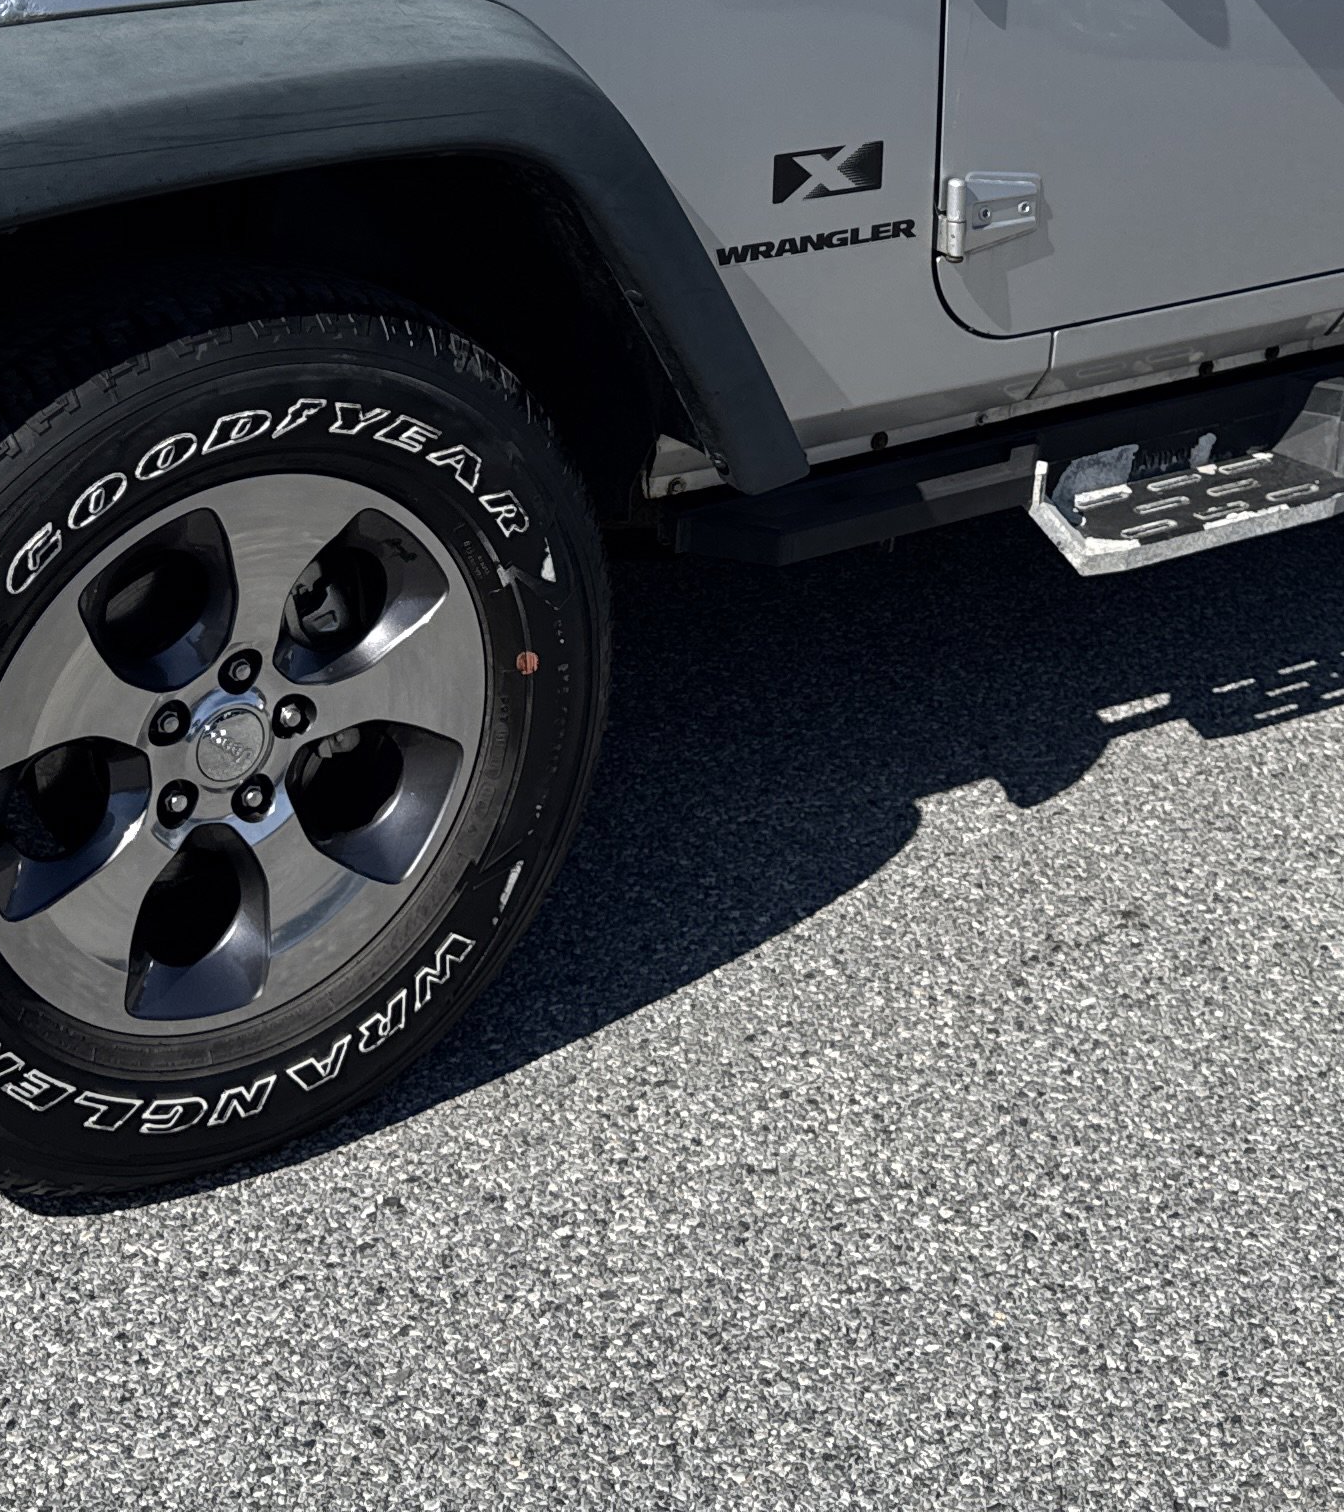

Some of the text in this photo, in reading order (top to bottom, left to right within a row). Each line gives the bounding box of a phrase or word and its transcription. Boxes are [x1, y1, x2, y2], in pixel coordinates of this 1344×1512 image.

[778, 141, 872, 204] X
[715, 218, 917, 267] WRANGLER
[5, 397, 530, 595] GOODYEAR
